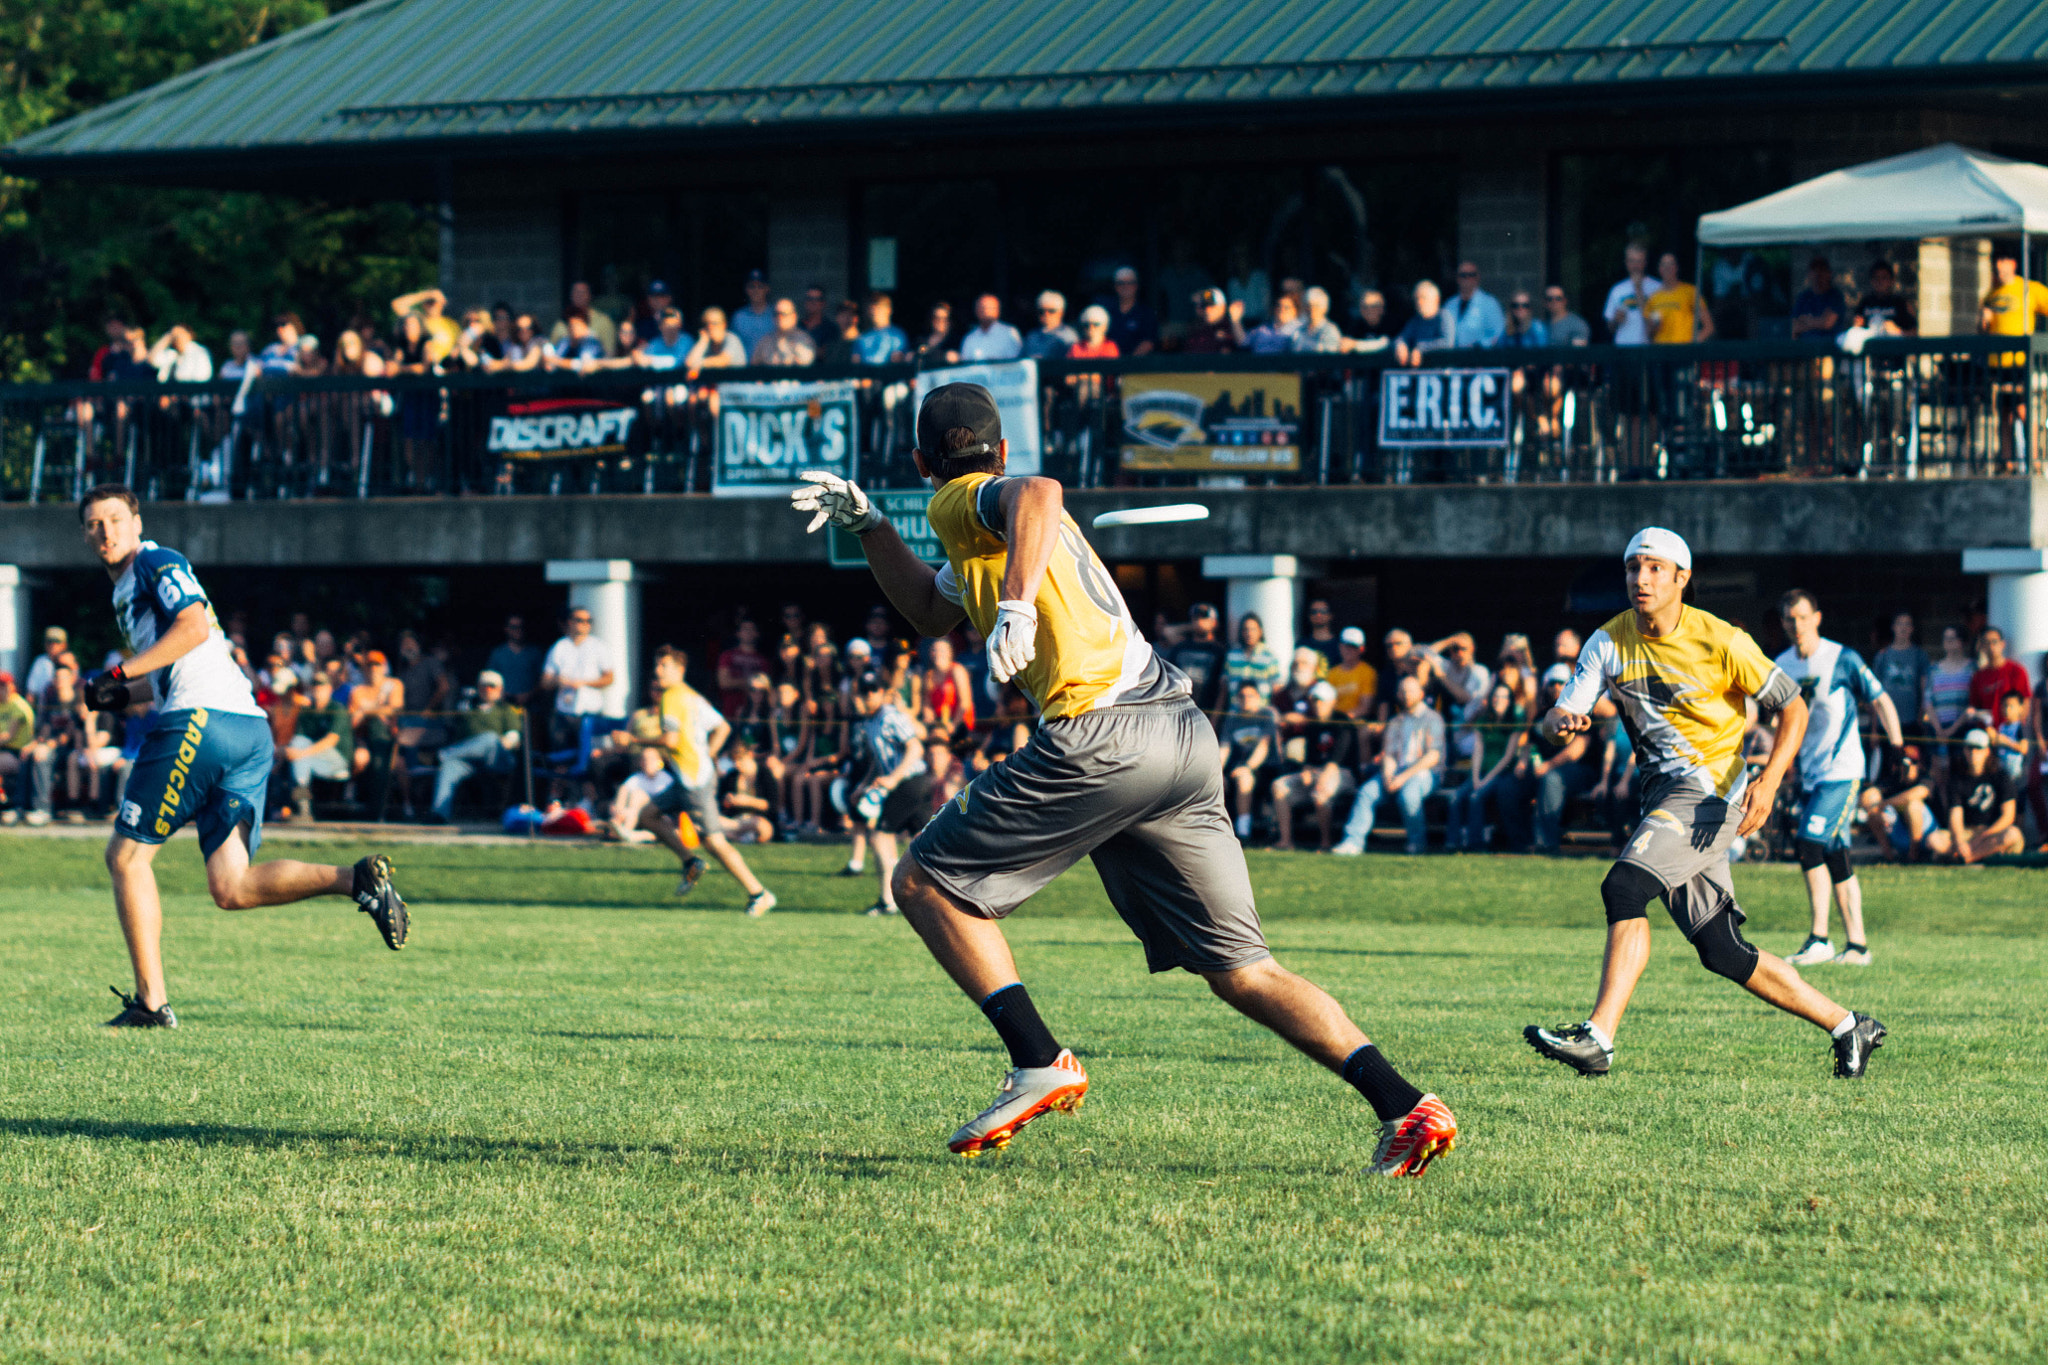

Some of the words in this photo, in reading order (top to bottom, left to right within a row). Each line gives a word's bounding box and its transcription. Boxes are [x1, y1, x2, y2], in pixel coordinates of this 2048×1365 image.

[488, 407, 637, 452] DISCRAFT
[724, 408, 846, 466] DICK'S
[154, 707, 209, 836] RADICALS
[1632, 829, 1655, 855] 4
